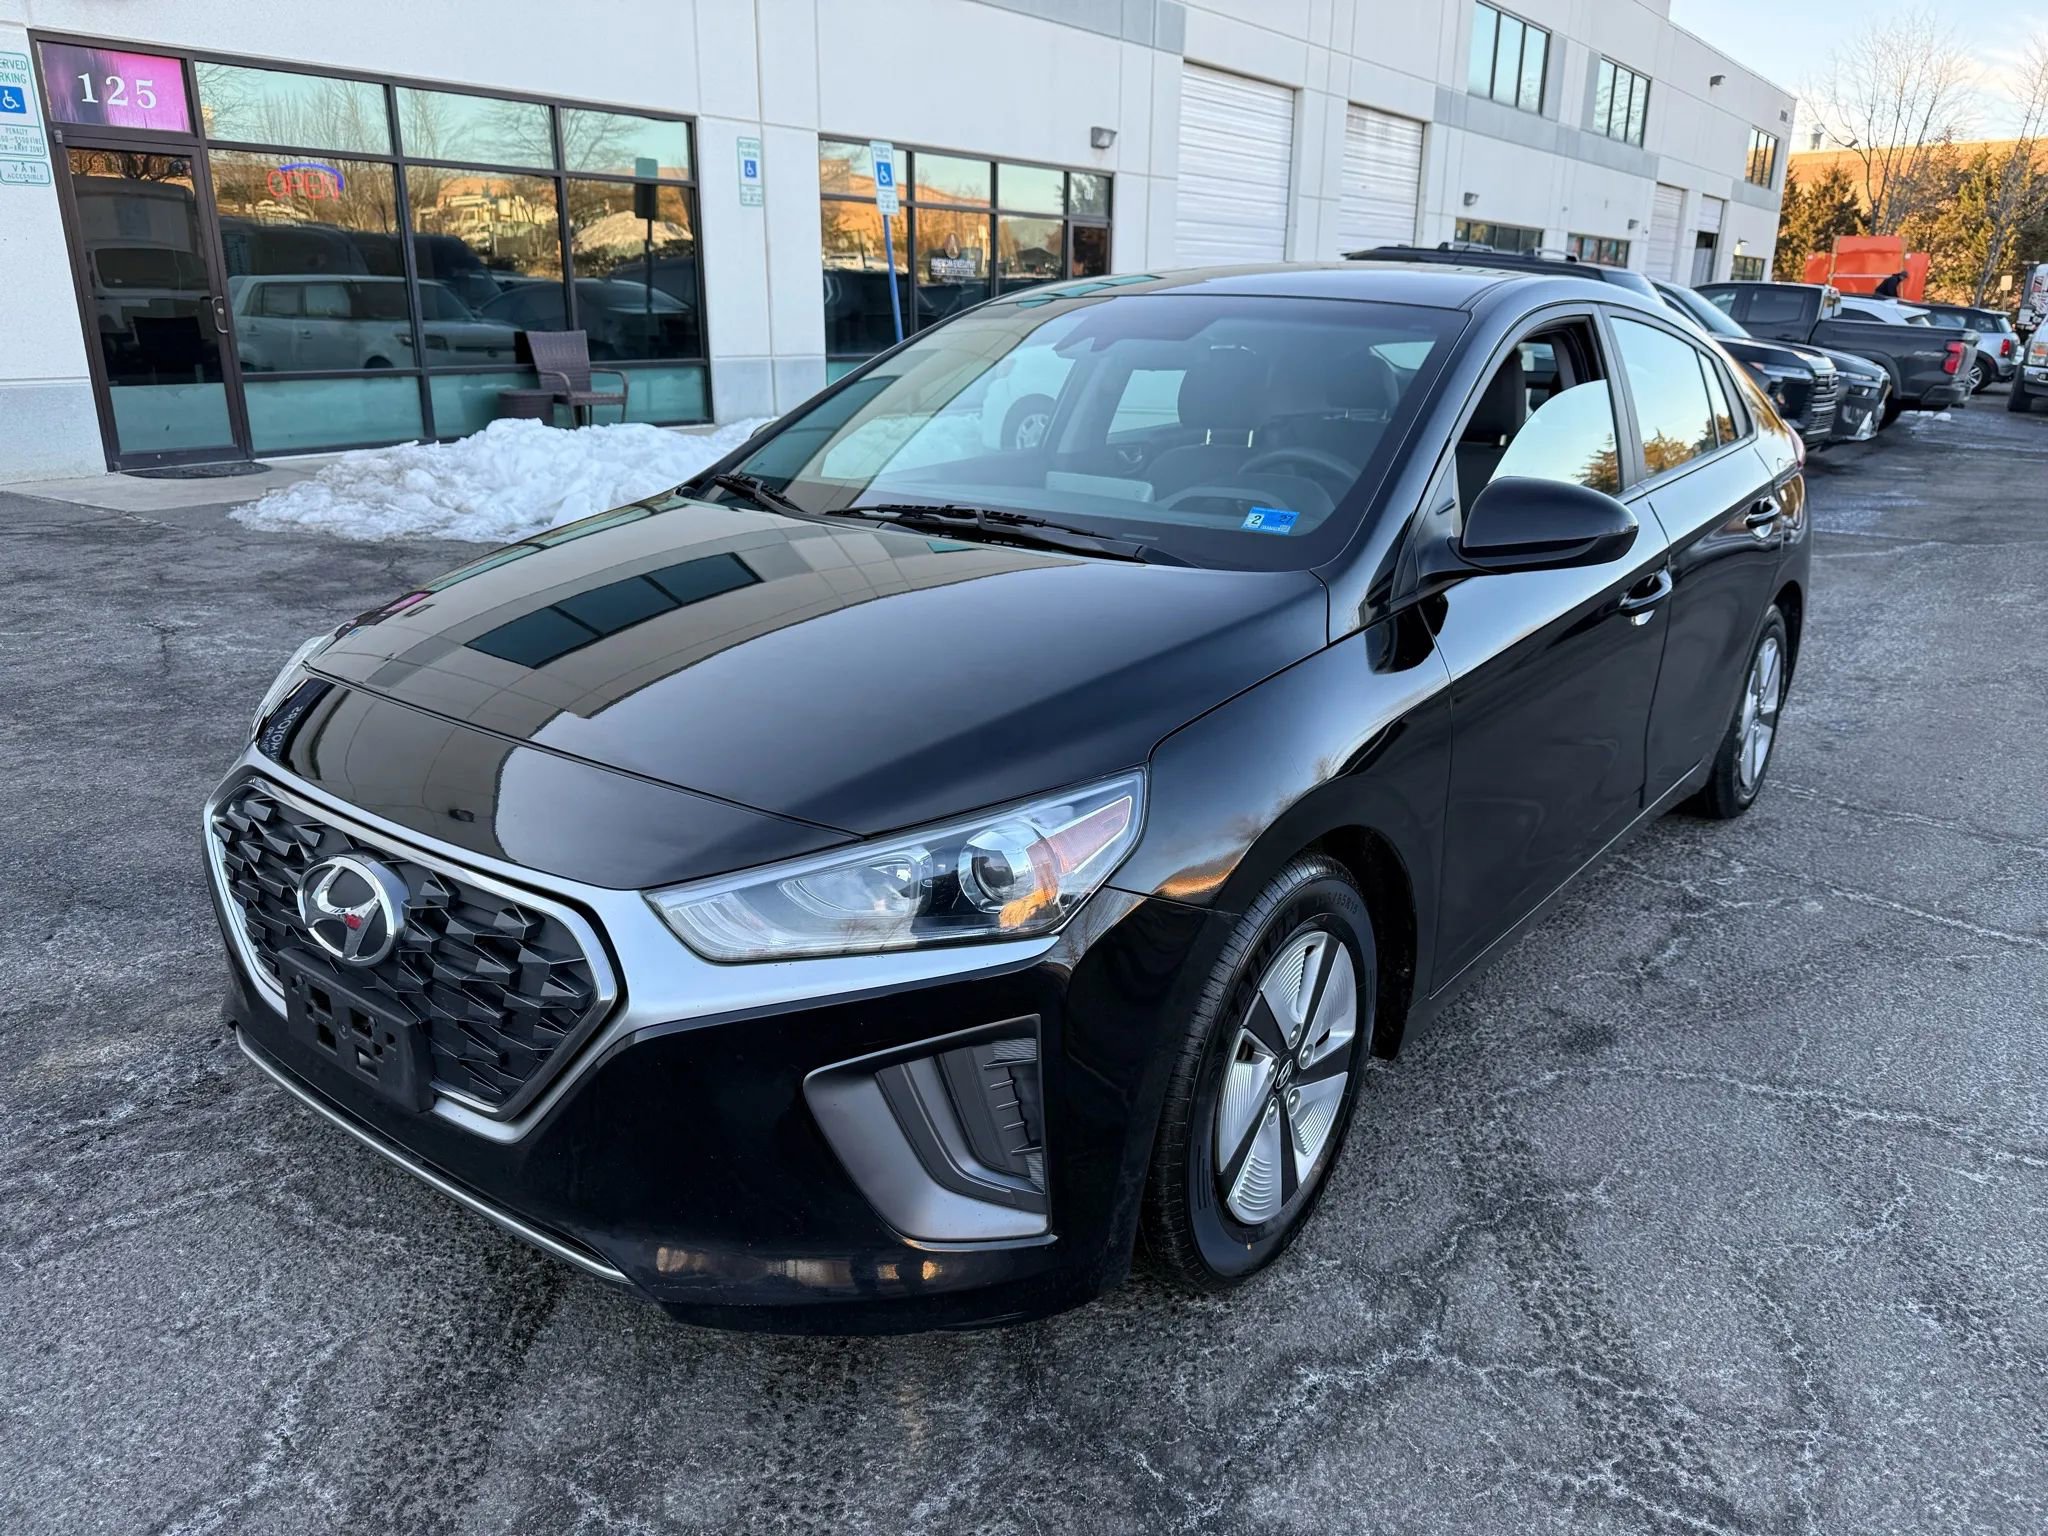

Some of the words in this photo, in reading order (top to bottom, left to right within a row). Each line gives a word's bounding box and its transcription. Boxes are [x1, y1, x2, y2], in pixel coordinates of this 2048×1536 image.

[78, 73, 156, 108] 125
[5, 127, 28, 135] PENALTY
[12, 164, 36, 173] VAN
[268, 170, 339, 200] OPEN
[1251, 514, 1262, 525] 2
